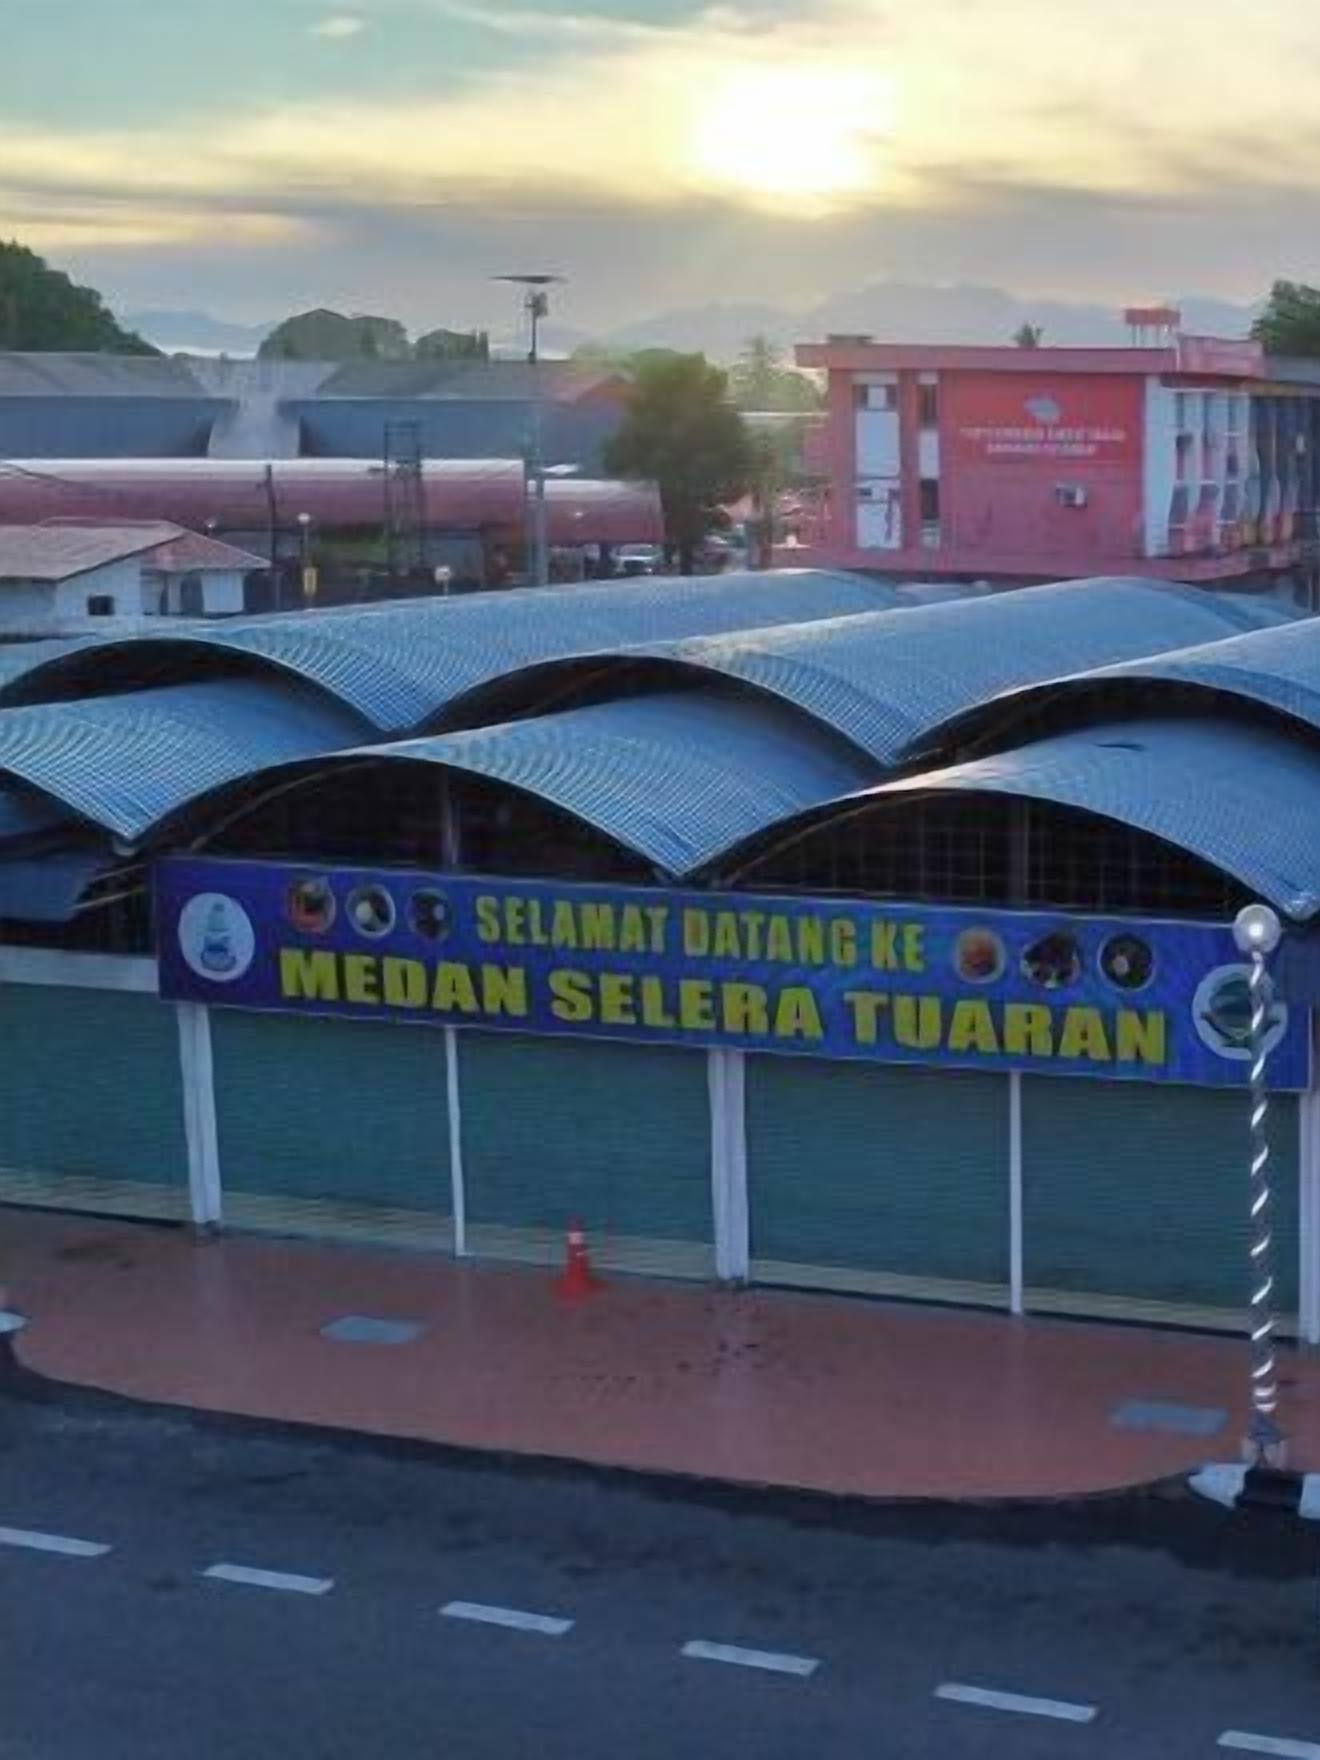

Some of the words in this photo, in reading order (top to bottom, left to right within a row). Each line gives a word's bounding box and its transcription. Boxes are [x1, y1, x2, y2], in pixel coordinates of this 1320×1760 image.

[475, 895, 668, 955] SELAMAT
[683, 907, 857, 968] DATANG
[871, 918, 924, 973] KE
[279, 947, 528, 1017] MEDAN
[548, 968, 824, 1040] SELERA
[843, 990, 1166, 1065] TUARAN
